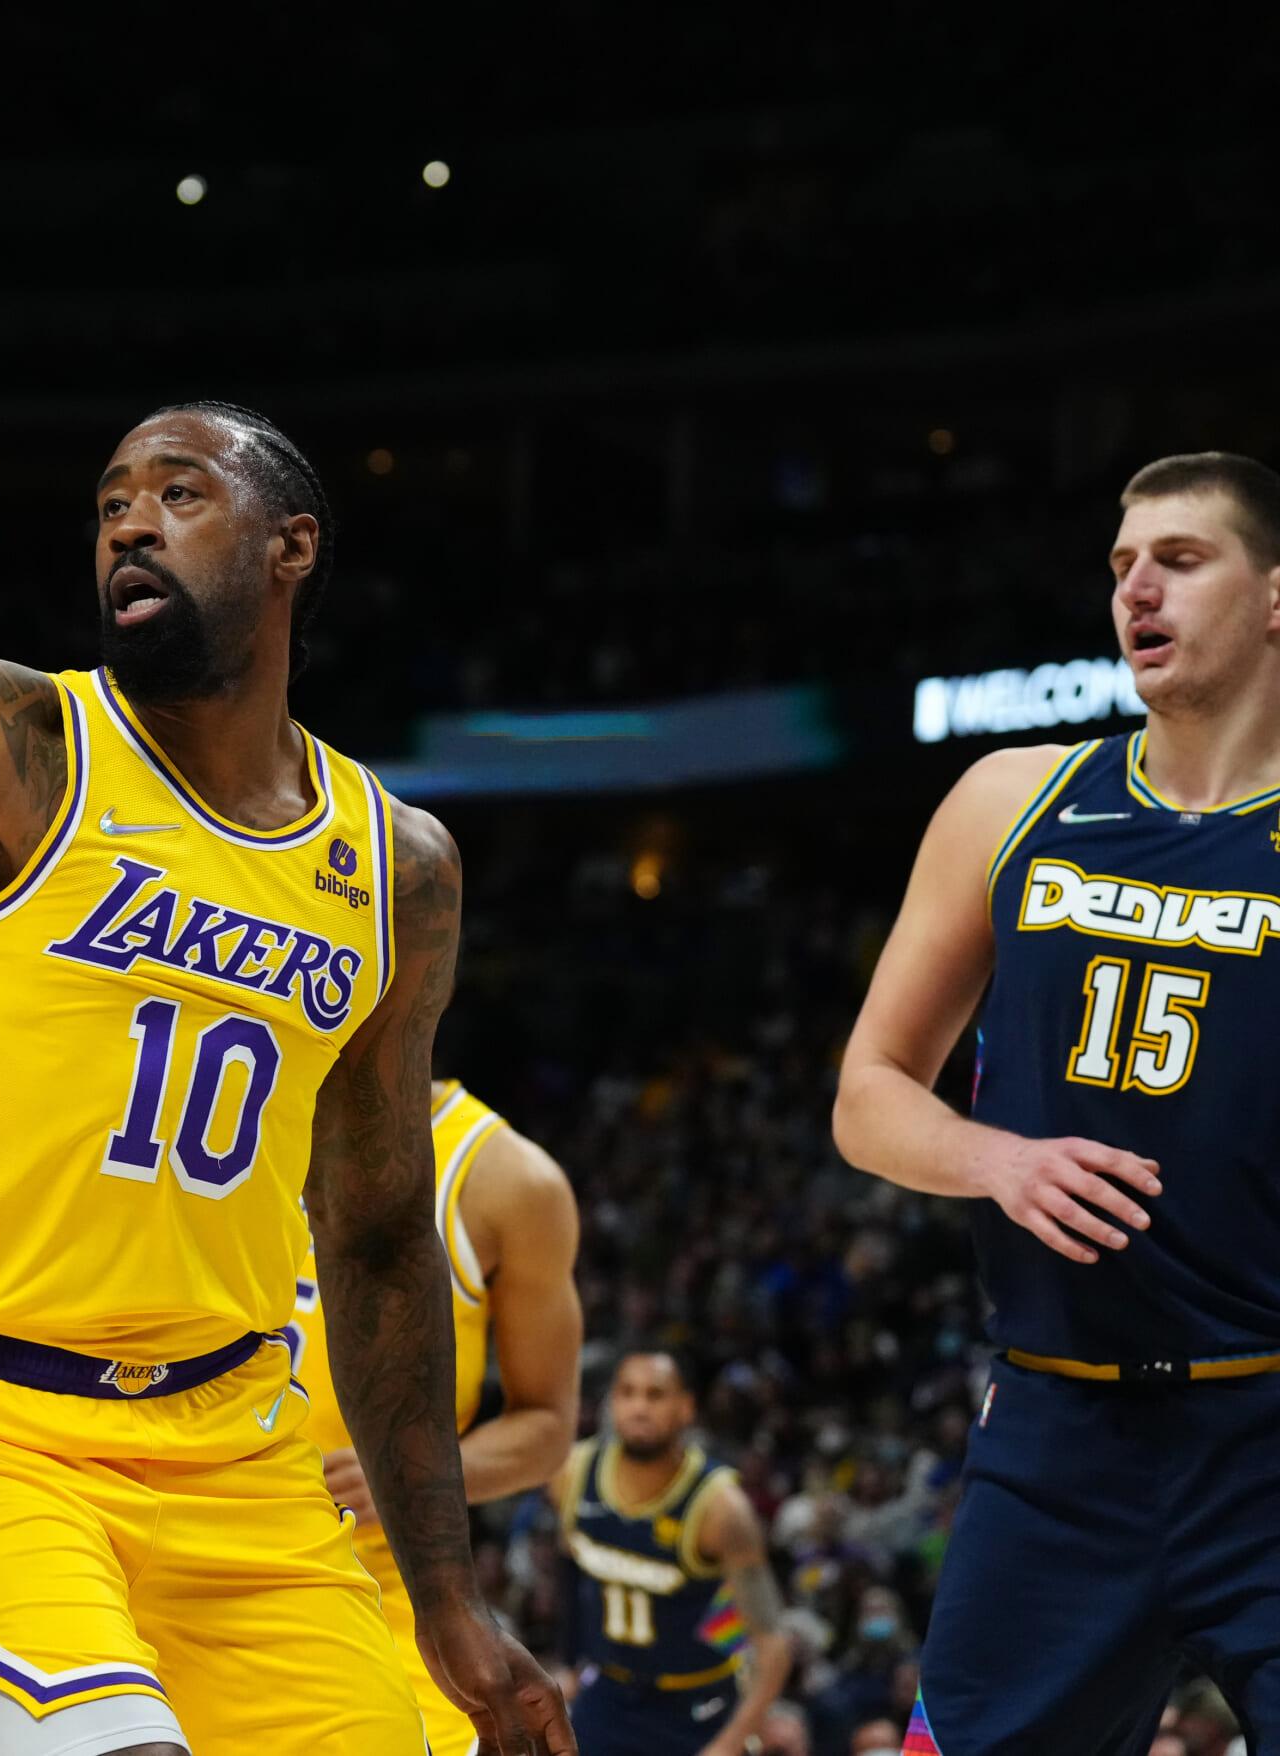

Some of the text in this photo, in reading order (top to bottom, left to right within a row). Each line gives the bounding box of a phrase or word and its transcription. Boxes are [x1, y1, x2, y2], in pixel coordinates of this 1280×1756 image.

[43, 855, 364, 1033] LAKERS
[315, 869, 370, 909] bibigo
[1066, 955, 1211, 1095] 15
[98, 995, 283, 1200] 10
[99, 1360, 168, 1385] LAKERS
